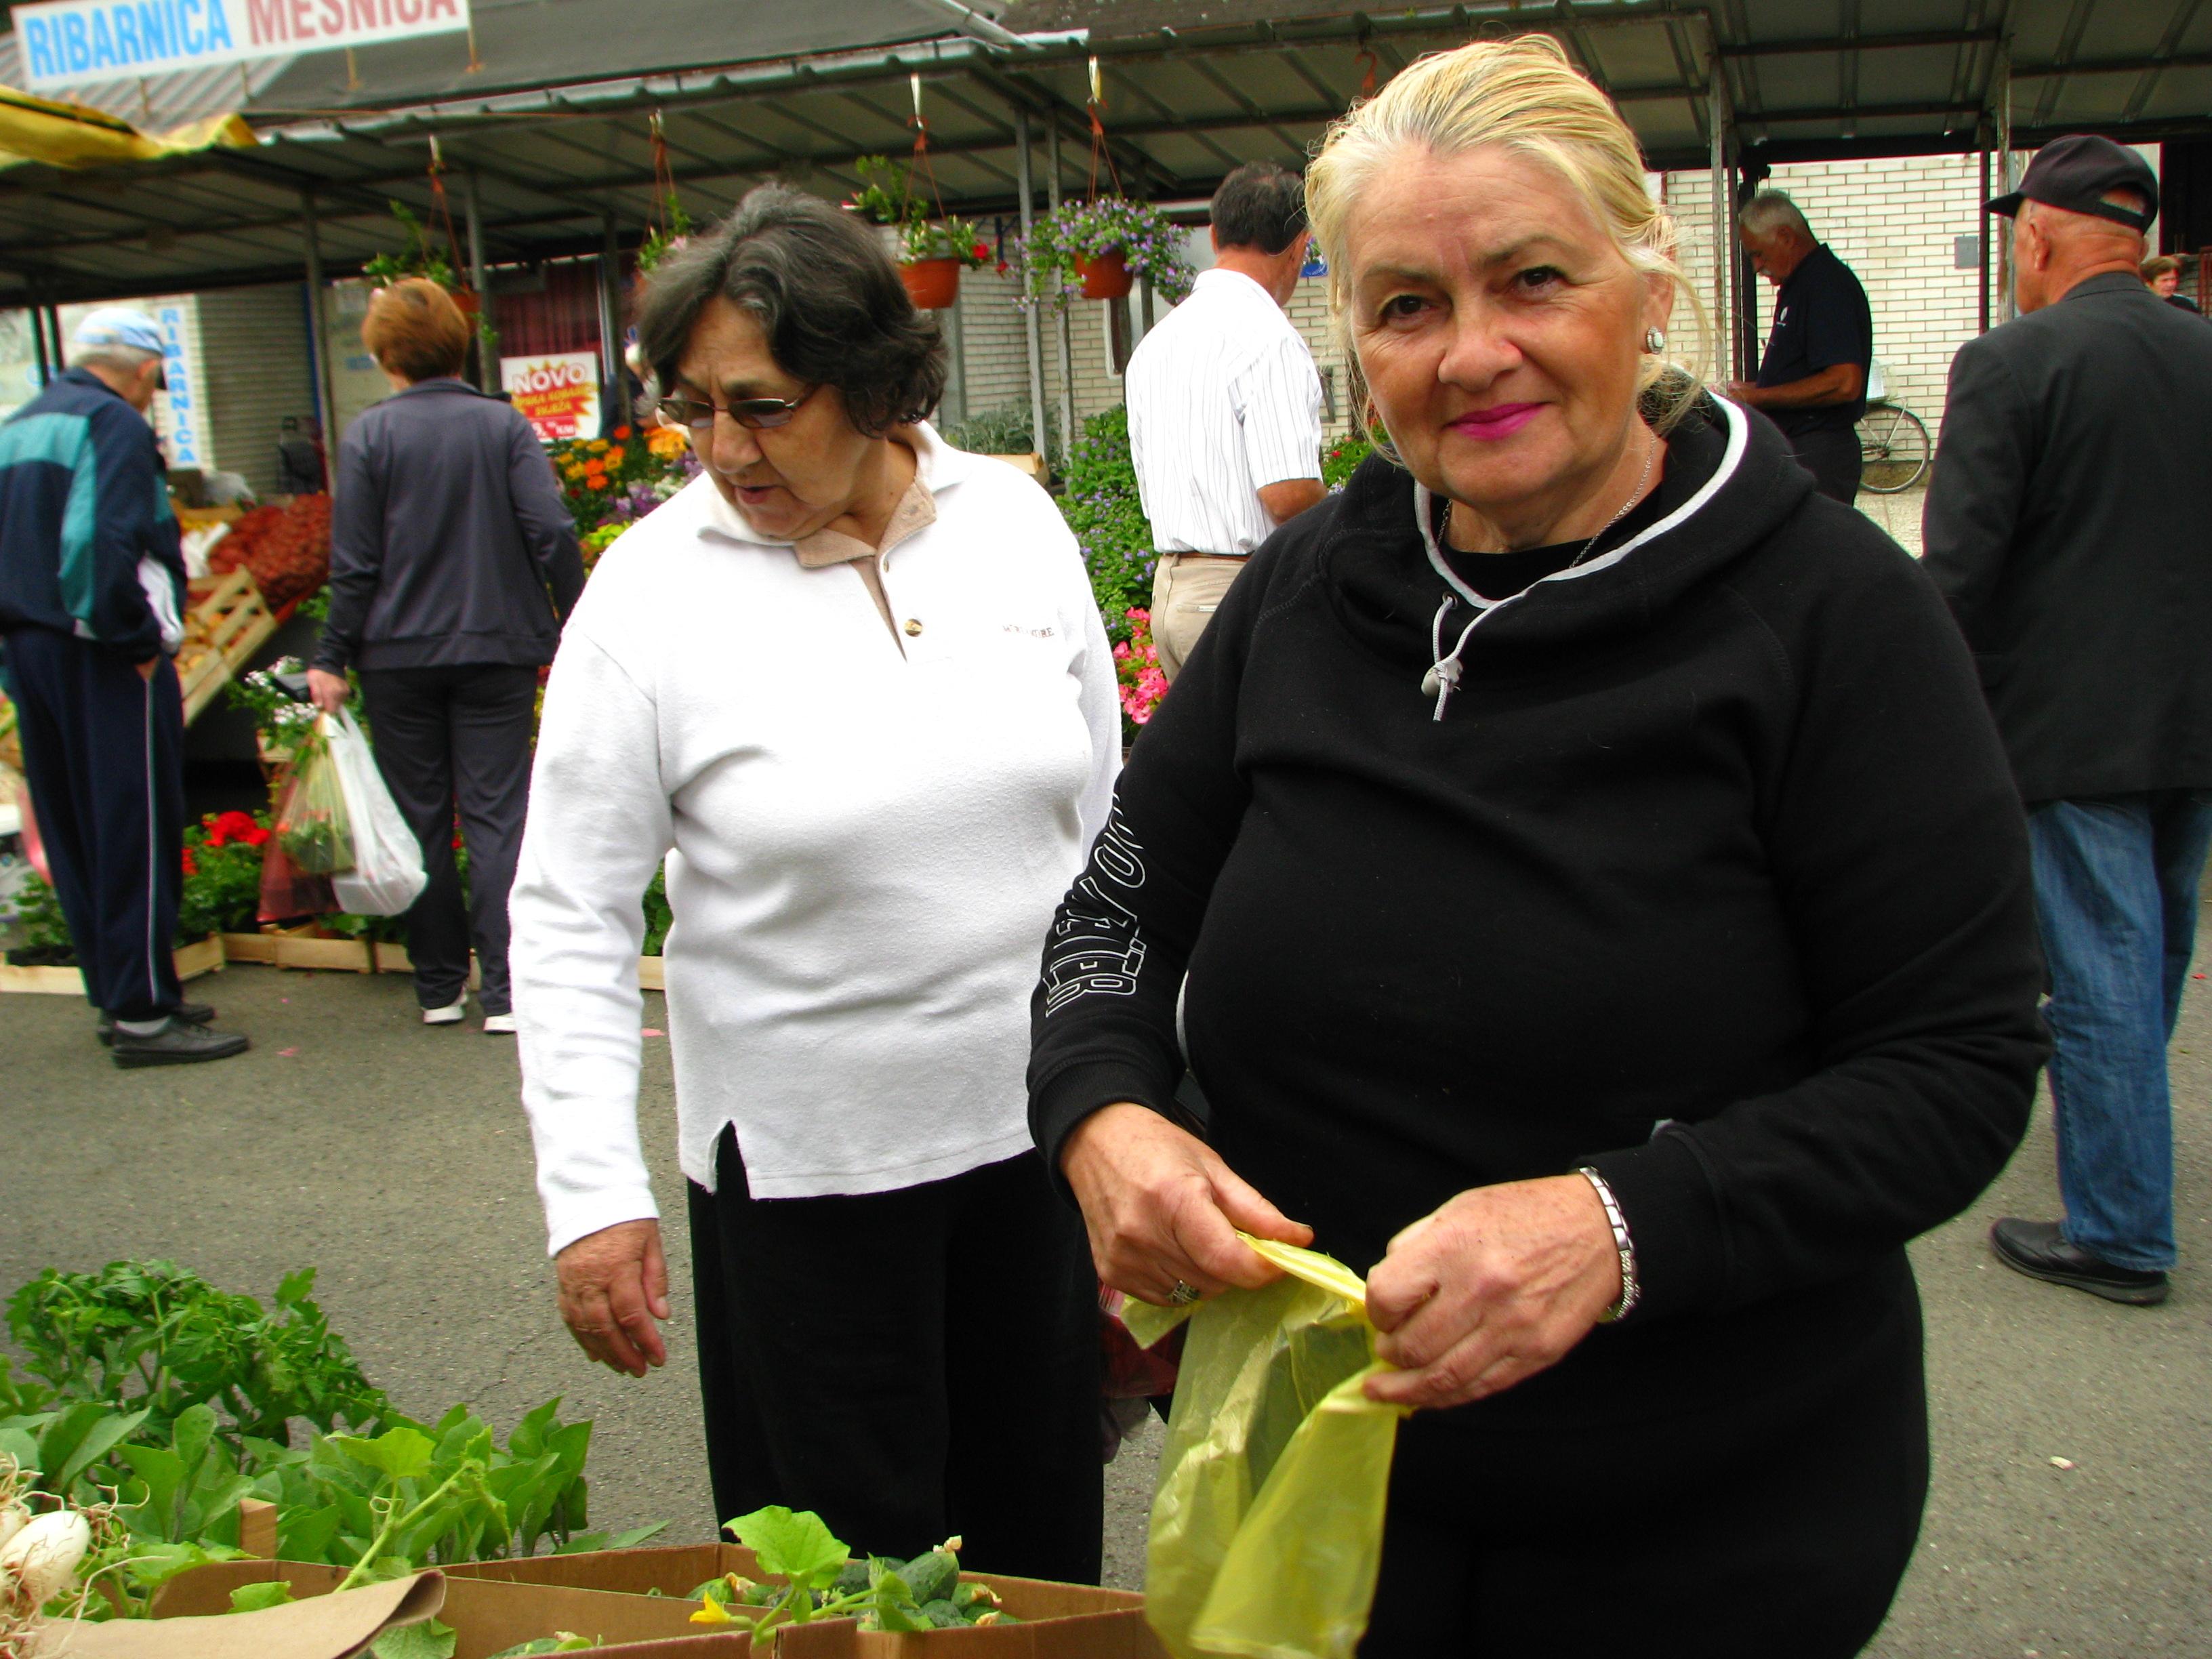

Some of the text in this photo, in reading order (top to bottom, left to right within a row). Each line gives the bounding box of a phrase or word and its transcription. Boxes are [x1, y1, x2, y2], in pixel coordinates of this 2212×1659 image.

[25, 0, 233, 78] RIBARNICA
[161, 308, 195, 462] RIBARNICA
[512, 363, 586, 394] NOVO
